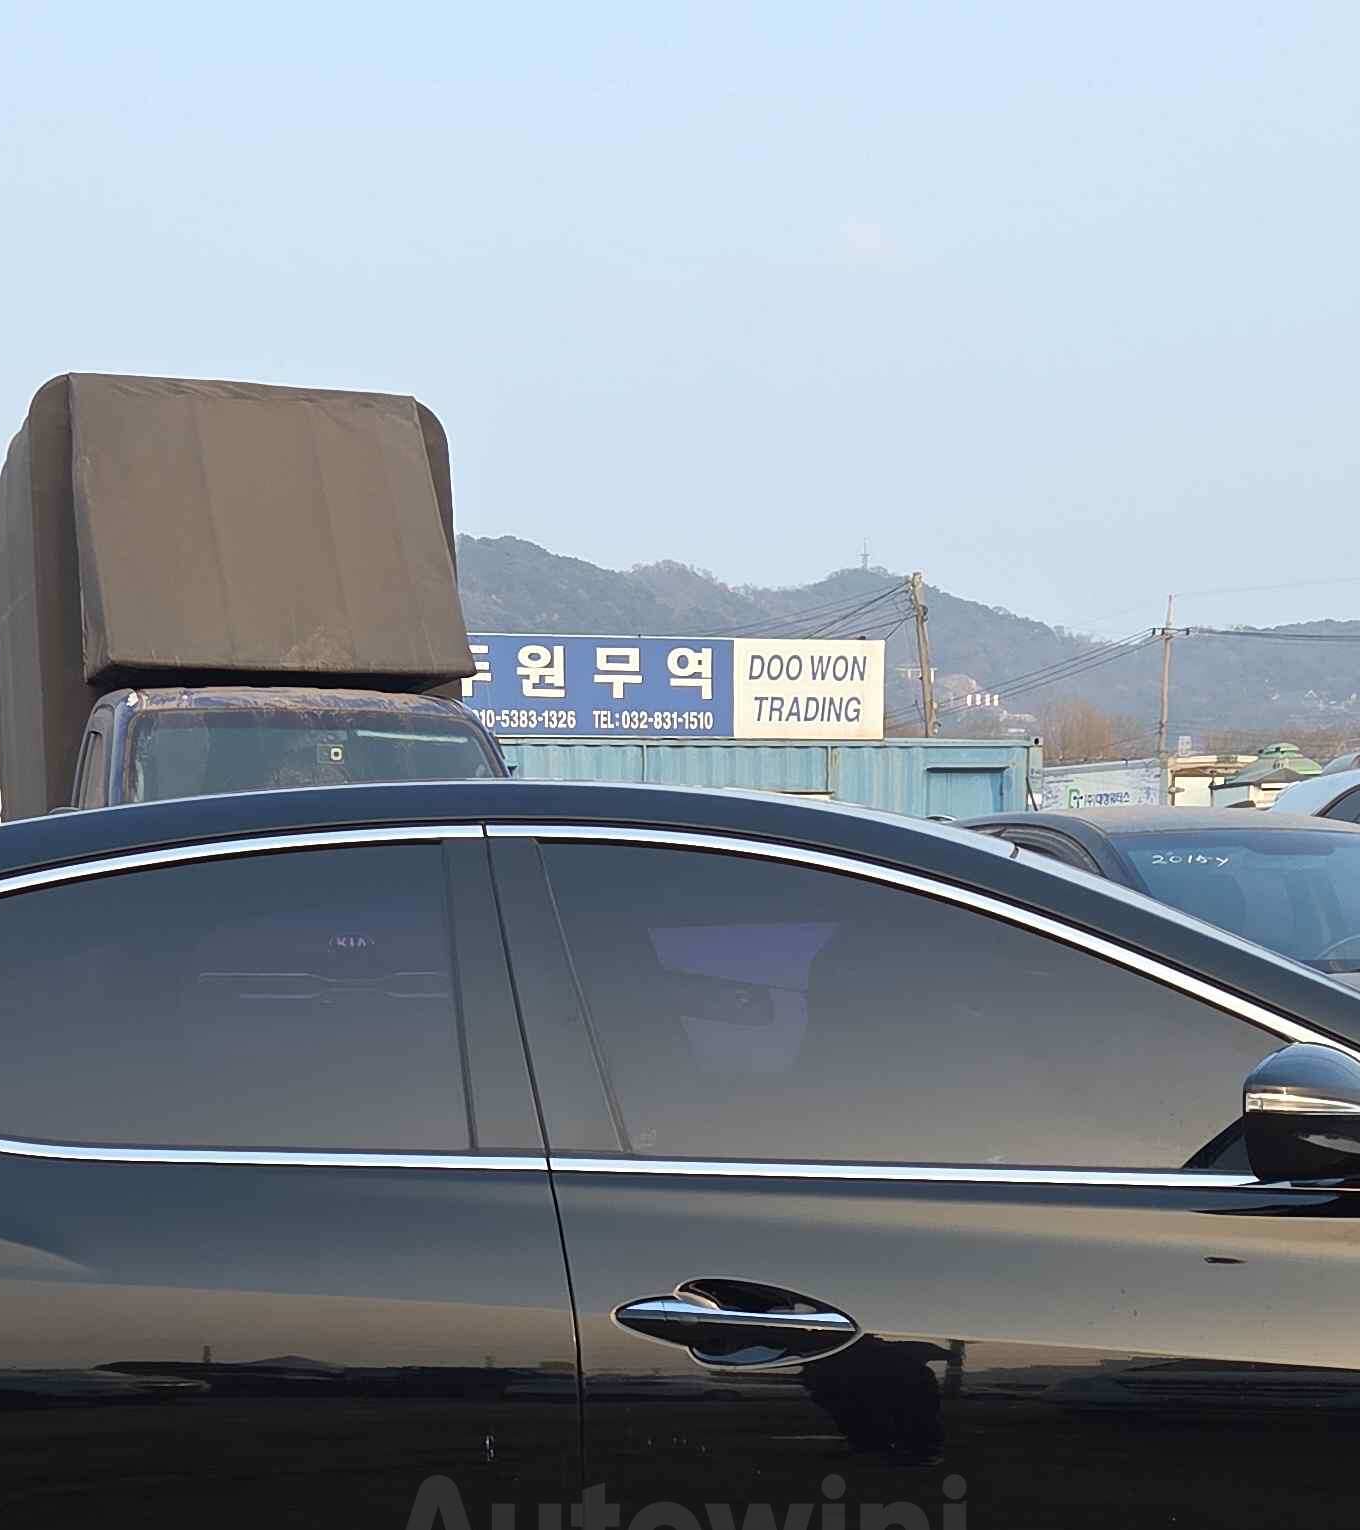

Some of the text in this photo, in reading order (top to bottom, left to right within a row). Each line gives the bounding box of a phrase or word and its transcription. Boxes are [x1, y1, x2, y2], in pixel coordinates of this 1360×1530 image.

[748, 654, 867, 681] DOO WON
[753, 695, 862, 723] TRADING
